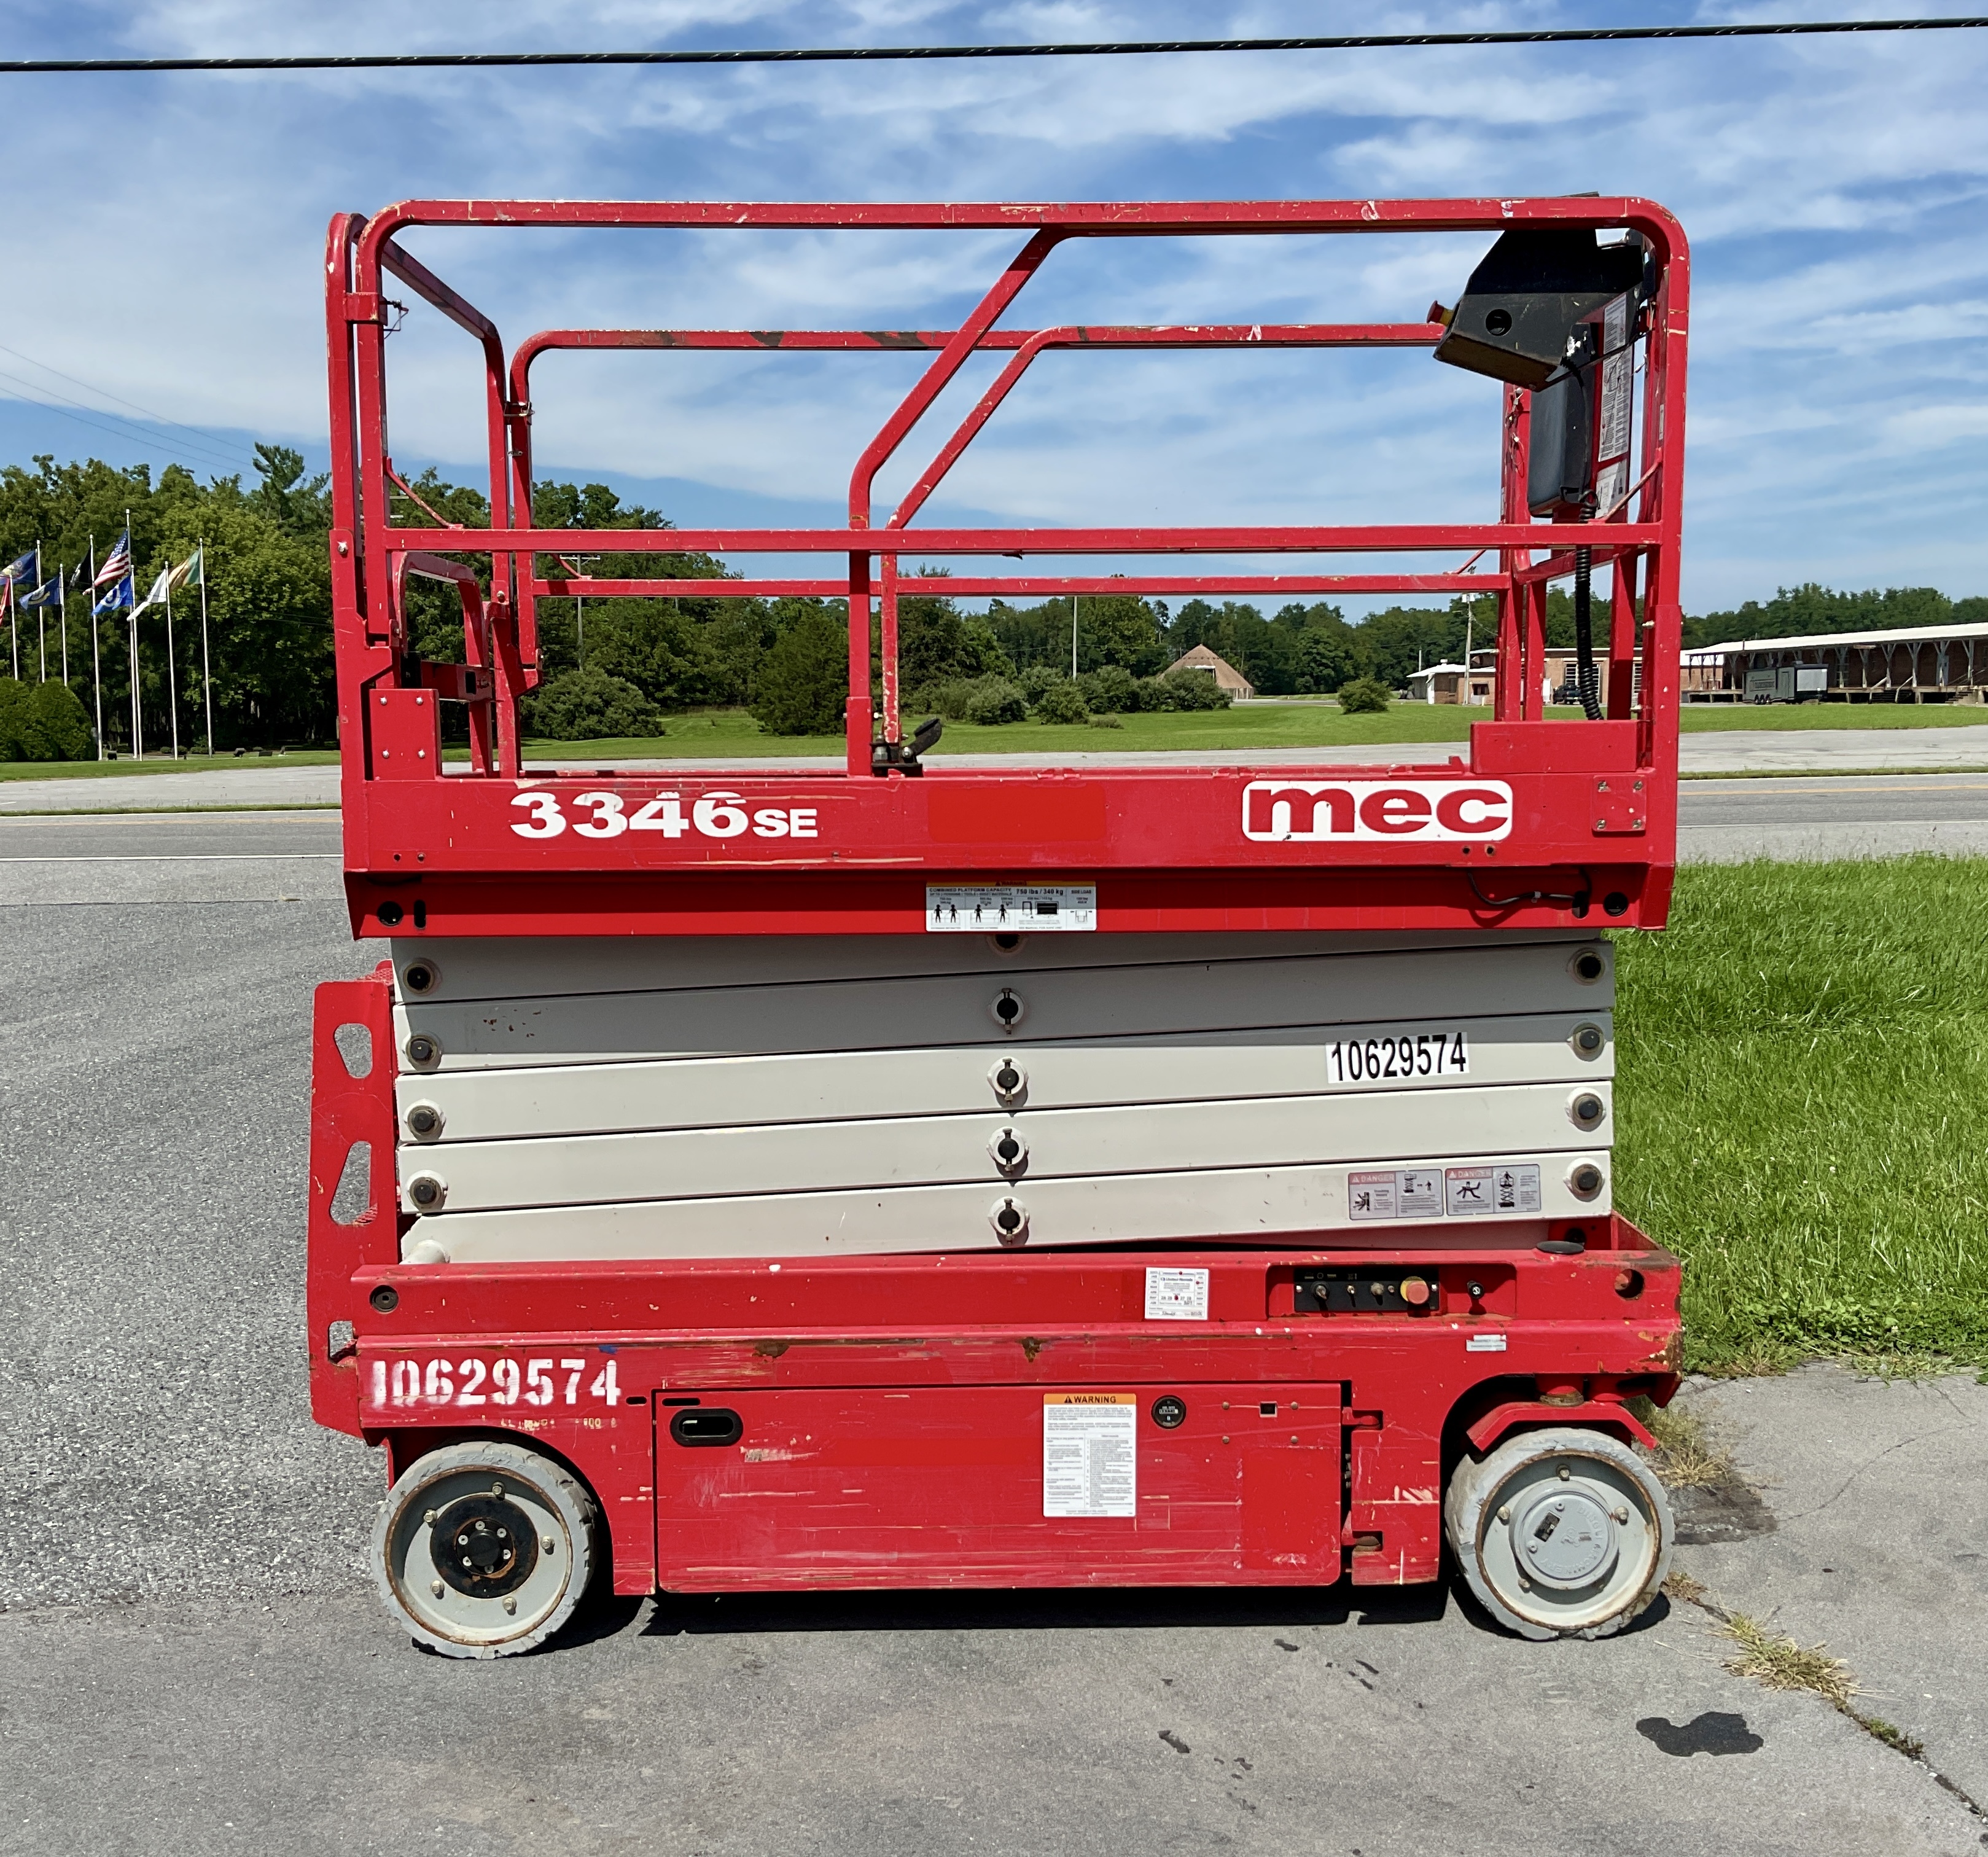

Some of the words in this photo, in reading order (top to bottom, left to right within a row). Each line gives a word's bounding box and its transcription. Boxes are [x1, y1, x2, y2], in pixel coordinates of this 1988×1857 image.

[1248, 788, 1508, 834] mec
[1331, 1032, 1467, 1081] 10629574
[1361, 1173, 1395, 1183] DANGER
[1457, 1169, 1492, 1178] DANGER
[372, 1358, 621, 1408] 10629574
[1074, 1395, 1117, 1404] WARNING
